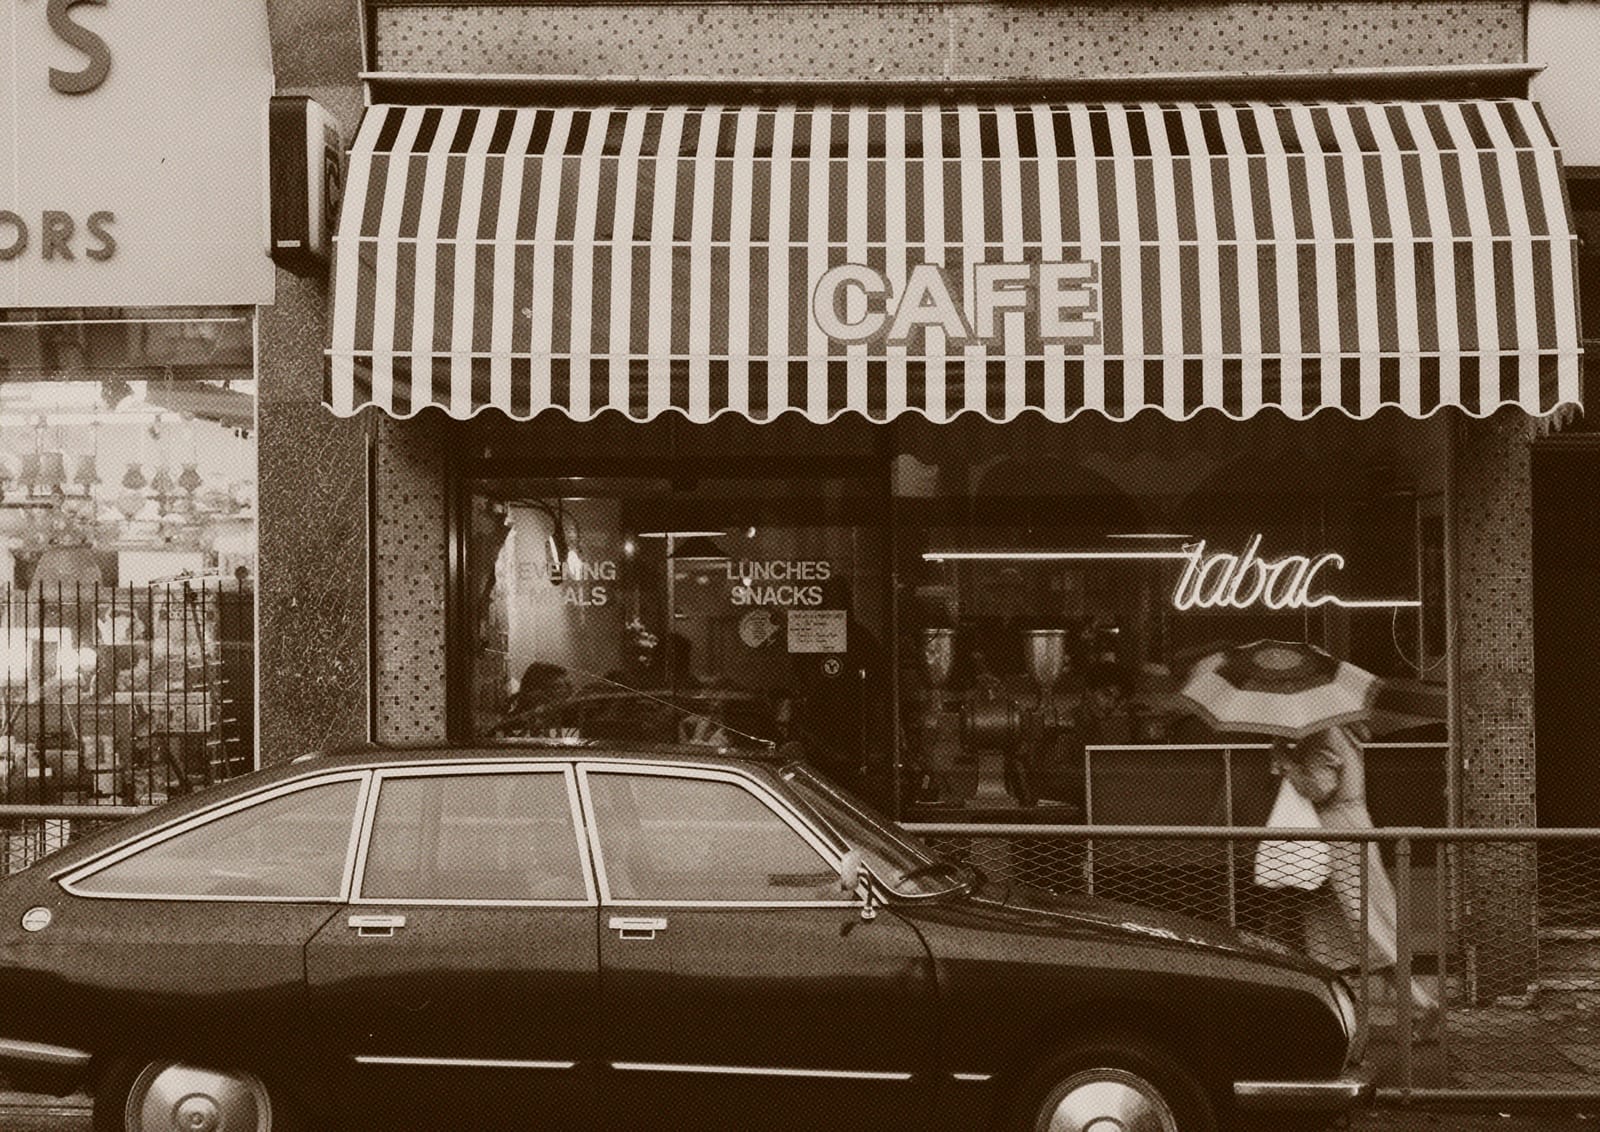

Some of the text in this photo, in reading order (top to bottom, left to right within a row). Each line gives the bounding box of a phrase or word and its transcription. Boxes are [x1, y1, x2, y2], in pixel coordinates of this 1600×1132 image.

[24, 0, 112, 97] S
[812, 260, 1101, 346] CAFE
[726, 561, 831, 580] LUNCHES
[730, 585, 823, 605] SNACKS
[1172, 533, 1345, 611] tabac
